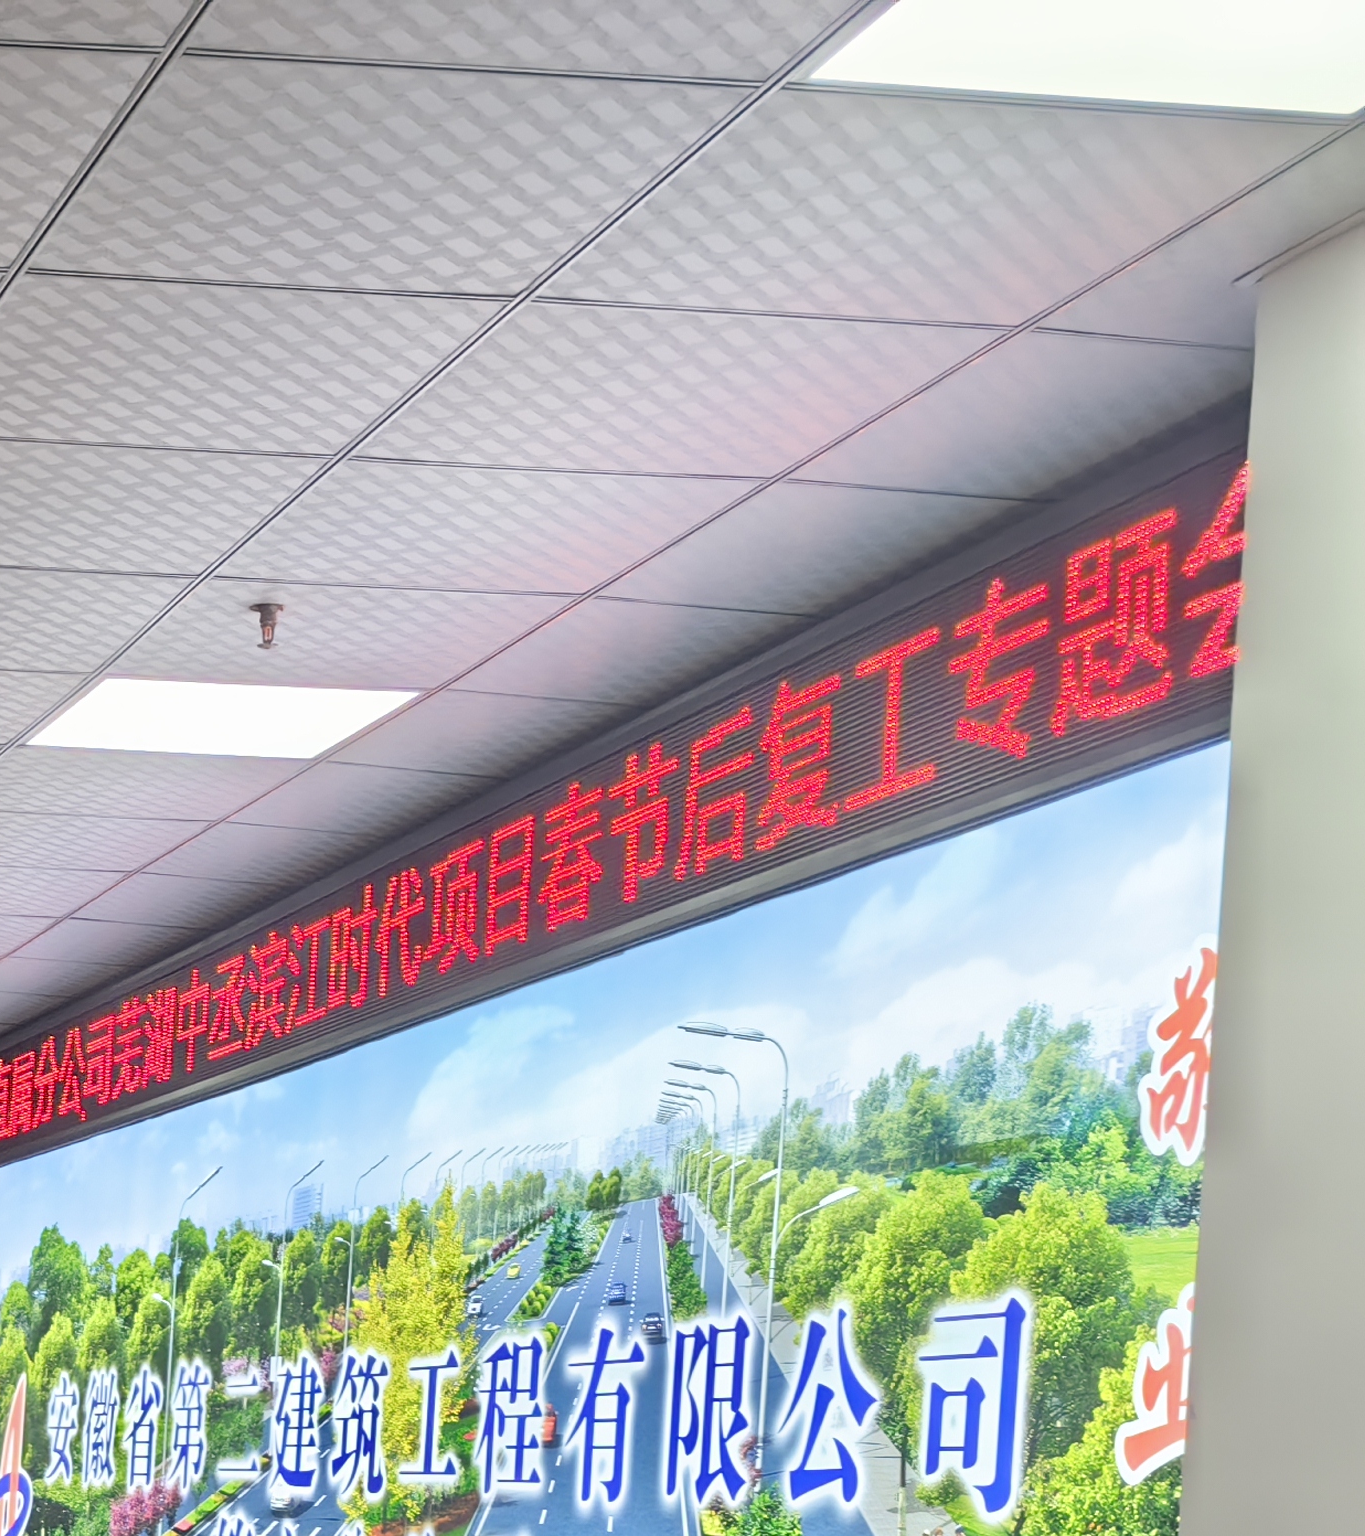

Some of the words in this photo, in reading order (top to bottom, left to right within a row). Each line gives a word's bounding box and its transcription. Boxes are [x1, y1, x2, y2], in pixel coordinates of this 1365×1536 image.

[45, 1297, 1029, 1513] 安徽省第二建筑工程有限公司
